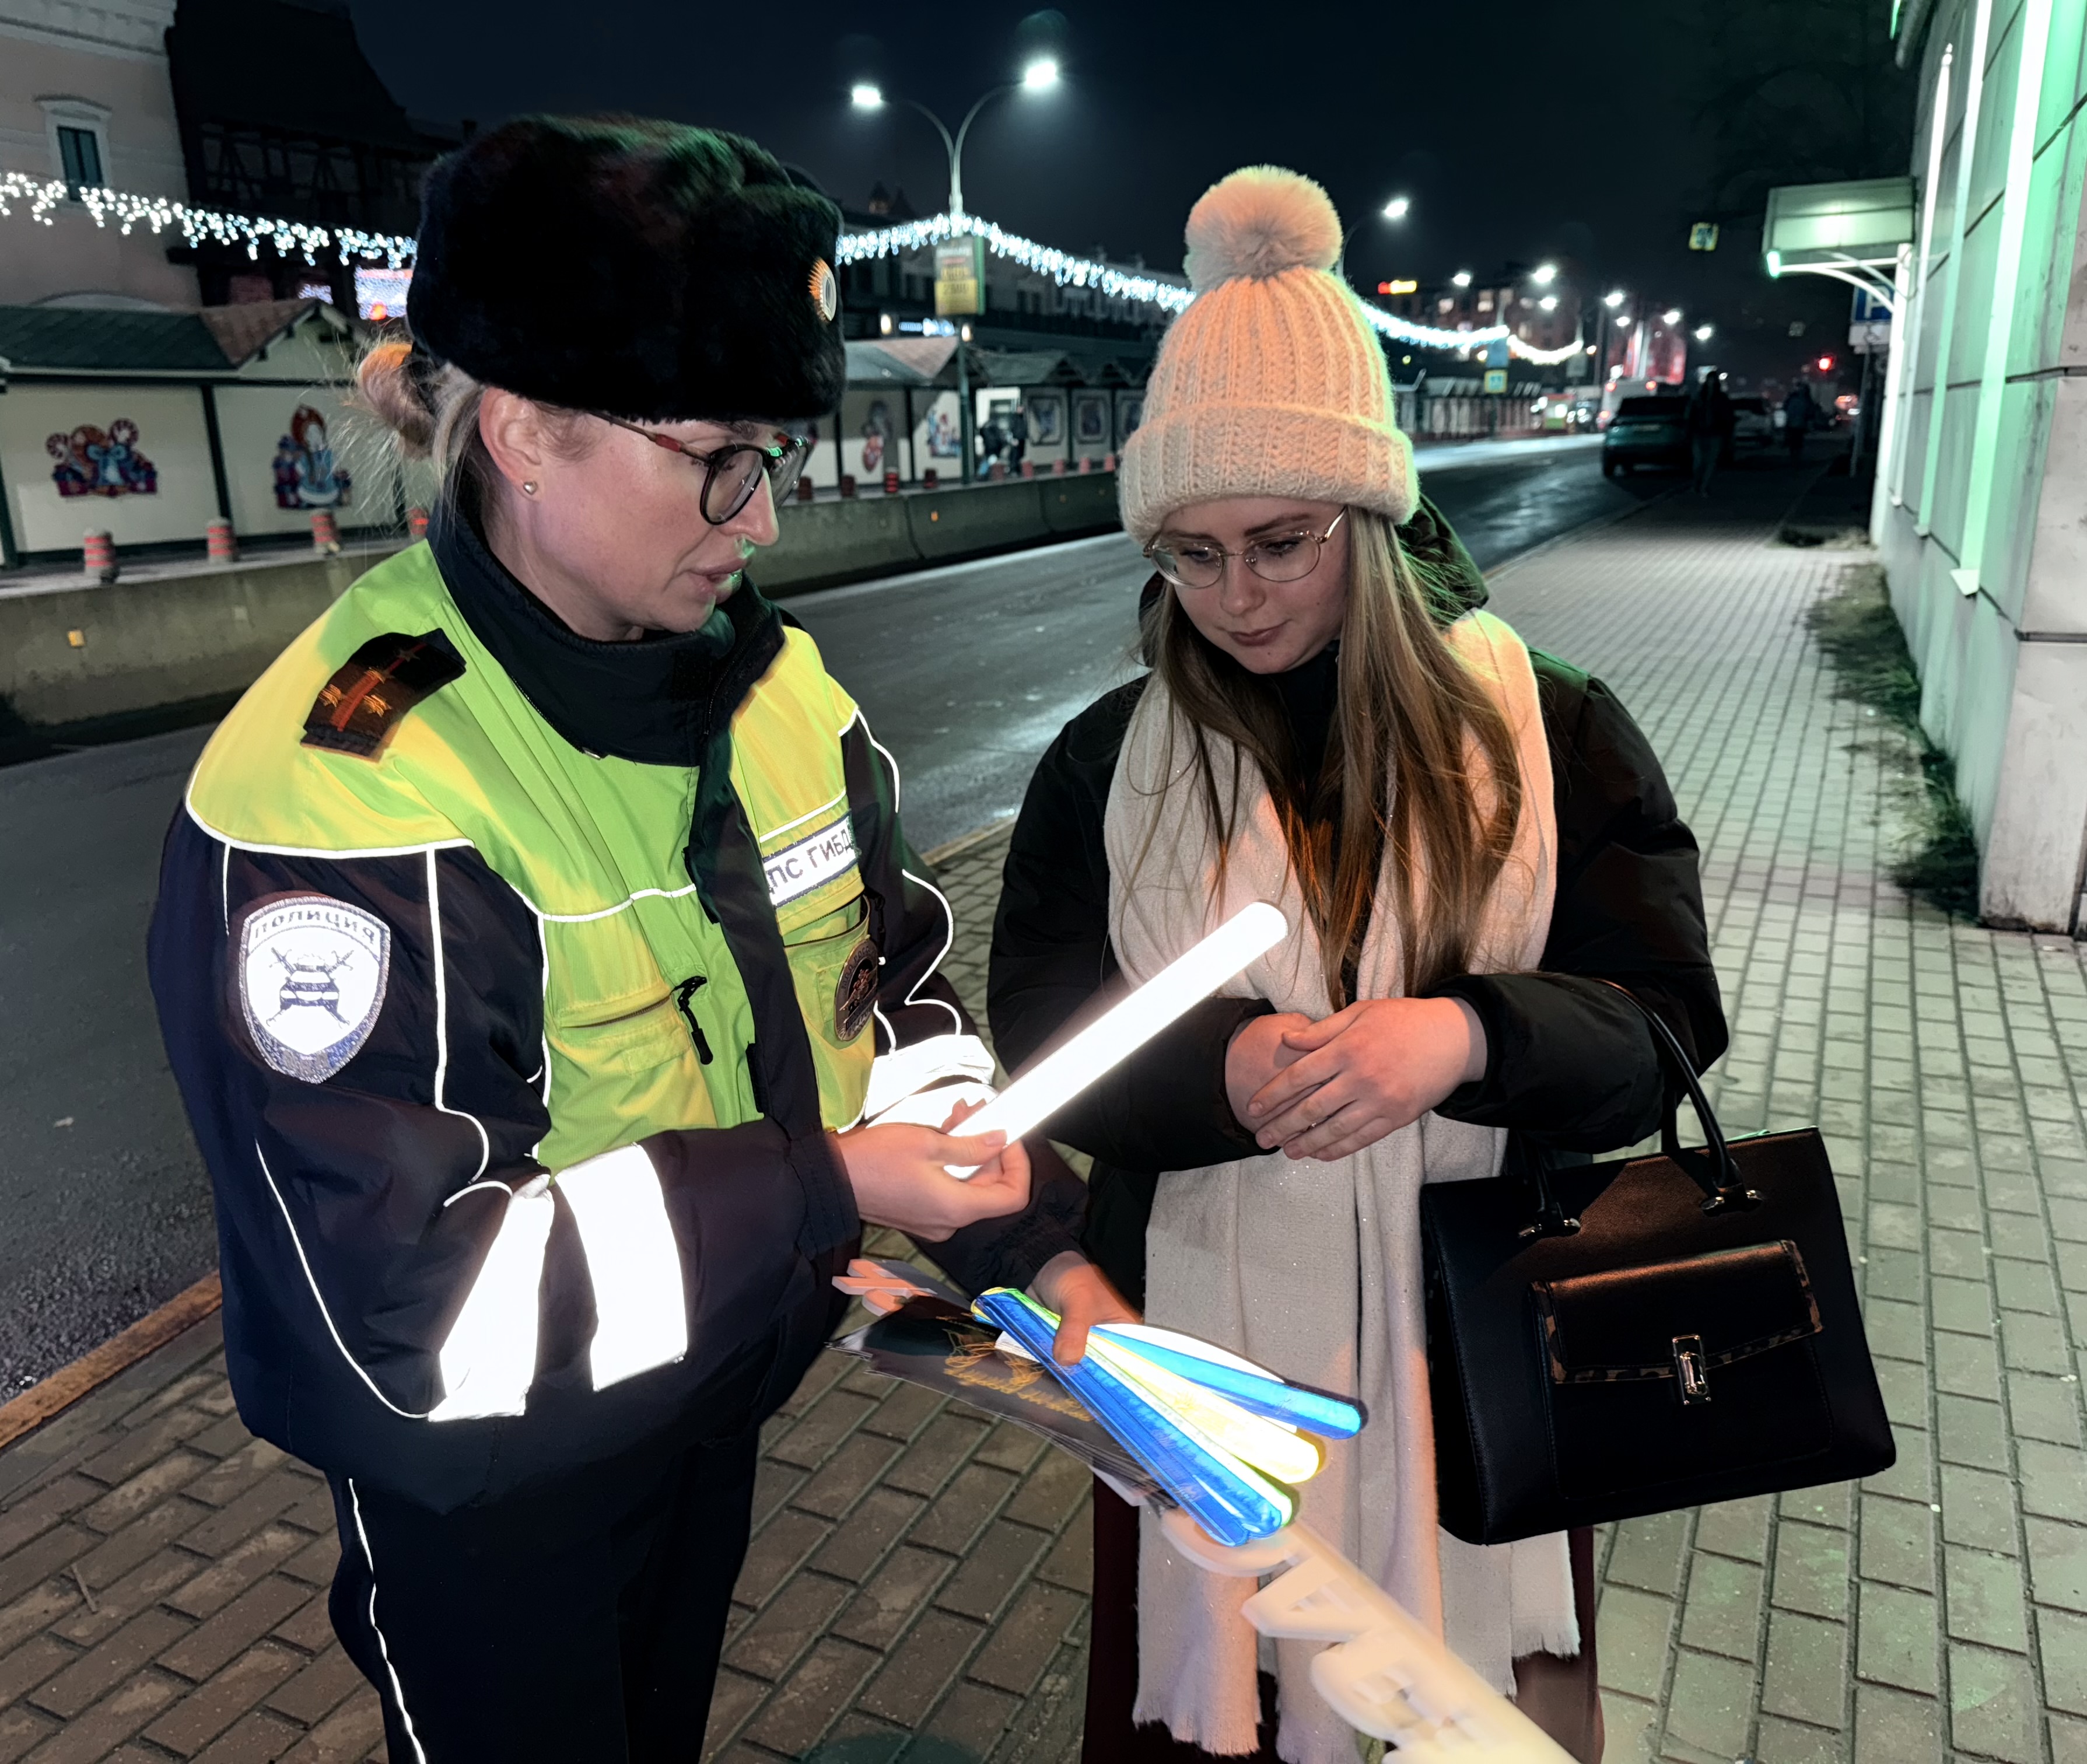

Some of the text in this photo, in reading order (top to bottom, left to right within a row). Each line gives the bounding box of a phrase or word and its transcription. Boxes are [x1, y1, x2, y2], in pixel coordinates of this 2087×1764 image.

[1864, 285, 1890, 318] P
[765, 828, 854, 894] ПС ГИБД
[255, 910, 375, 944] ПОЛИЦИЯ
